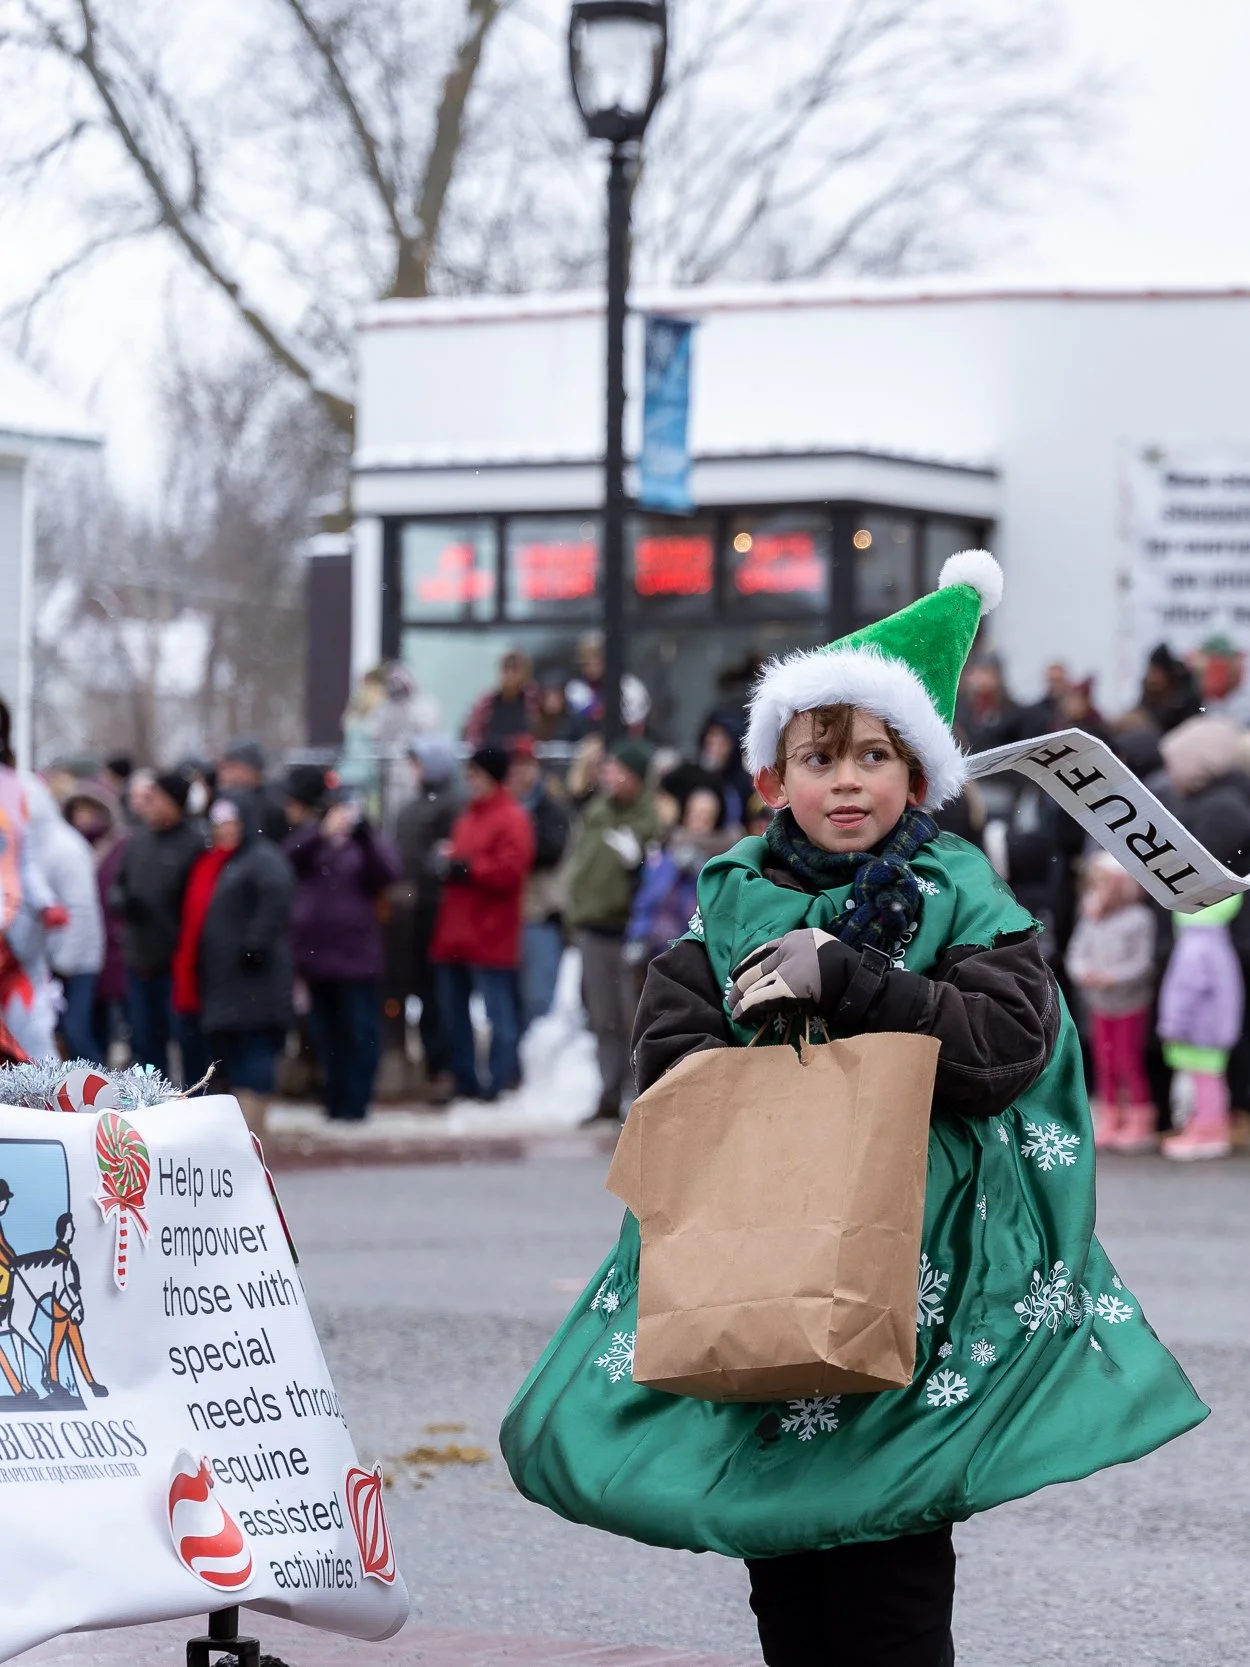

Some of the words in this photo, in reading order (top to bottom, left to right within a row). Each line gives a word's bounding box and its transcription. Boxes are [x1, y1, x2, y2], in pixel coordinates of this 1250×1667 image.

[158, 1157, 204, 1207] Help
[210, 1167, 234, 1198] us
[161, 1224, 268, 1266] empower
[163, 1276, 233, 1317] those
[237, 1269, 299, 1310] with
[169, 1327, 276, 1384] special
[186, 1386, 282, 1432] needs
[0, 1421, 66, 1461] BURY
[60, 1419, 148, 1459] CROSS
[45, 1463, 105, 1484] EQUESTRIAN
[103, 1462, 142, 1479] CENTER
[212, 1443, 310, 1492] equine
[238, 1491, 344, 1537] assisted
[269, 1549, 358, 1589] activities.
